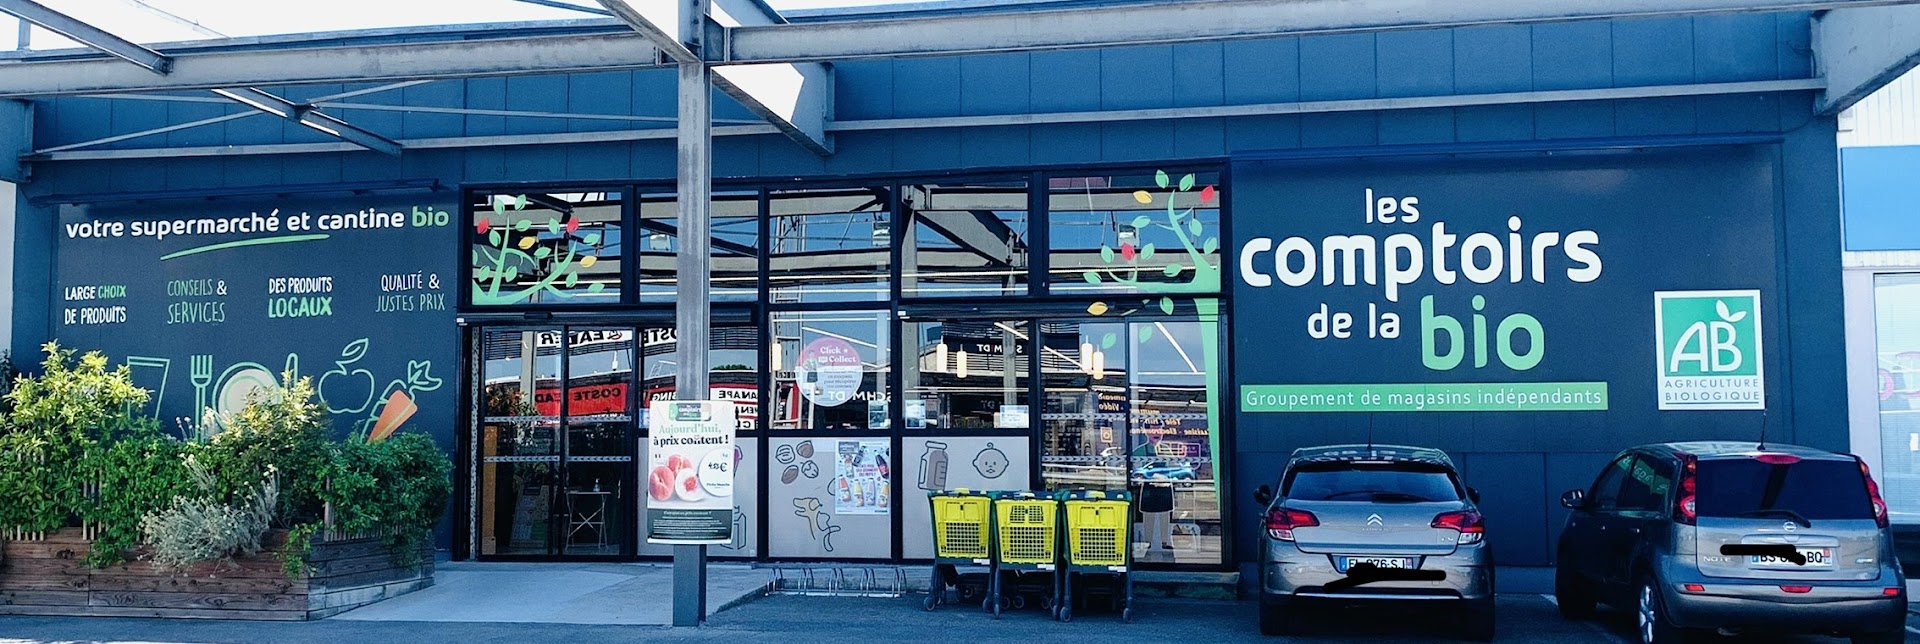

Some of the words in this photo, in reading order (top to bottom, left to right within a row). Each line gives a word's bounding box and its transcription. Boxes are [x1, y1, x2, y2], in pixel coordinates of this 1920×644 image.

[1366, 189, 1419, 223] les
[66, 220, 123, 238] votre
[131, 208, 279, 239] supermarché
[287, 212, 310, 230] et
[318, 208, 404, 229] cantine
[412, 206, 448, 226] bio
[1240, 216, 1602, 302] comptoirs
[168, 279, 212, 296] CONSEILS
[217, 281, 227, 295] &
[269, 278, 286, 294] DES
[288, 277, 332, 293] PRODUITS
[382, 270, 422, 292] QUALITÉ
[429, 274, 439, 289] &
[66, 286, 96, 300] LARGE
[98, 285, 126, 298] CHOIX
[269, 297, 332, 317] LOCAUX
[376, 295, 413, 312] JUSTES
[420, 293, 445, 311] PRIX
[65, 309, 76, 324] DE
[81, 306, 126, 324] PRODUITS
[167, 301, 225, 325] SERVICES
[1308, 303, 1352, 338] de
[1369, 303, 1401, 339] la
[1421, 295, 1544, 370] bio
[820, 346, 841, 354] Click
[1670, 320, 1743, 372] AB
[1664, 378, 1760, 390] AGRICULTURE
[1246, 389, 1356, 411] Groupement
[1360, 389, 1382, 407] de
[1388, 389, 1471, 411] magasins
[1477, 388, 1602, 410] indépendants
[1665, 391, 1760, 404] BIOLOGIQUE
[659, 424, 721, 435] Aujourd'hui,
[654, 436, 659, 445] à
[660, 436, 679, 447] prix
[681, 436, 723, 445] content
[725, 435, 729, 444] !
